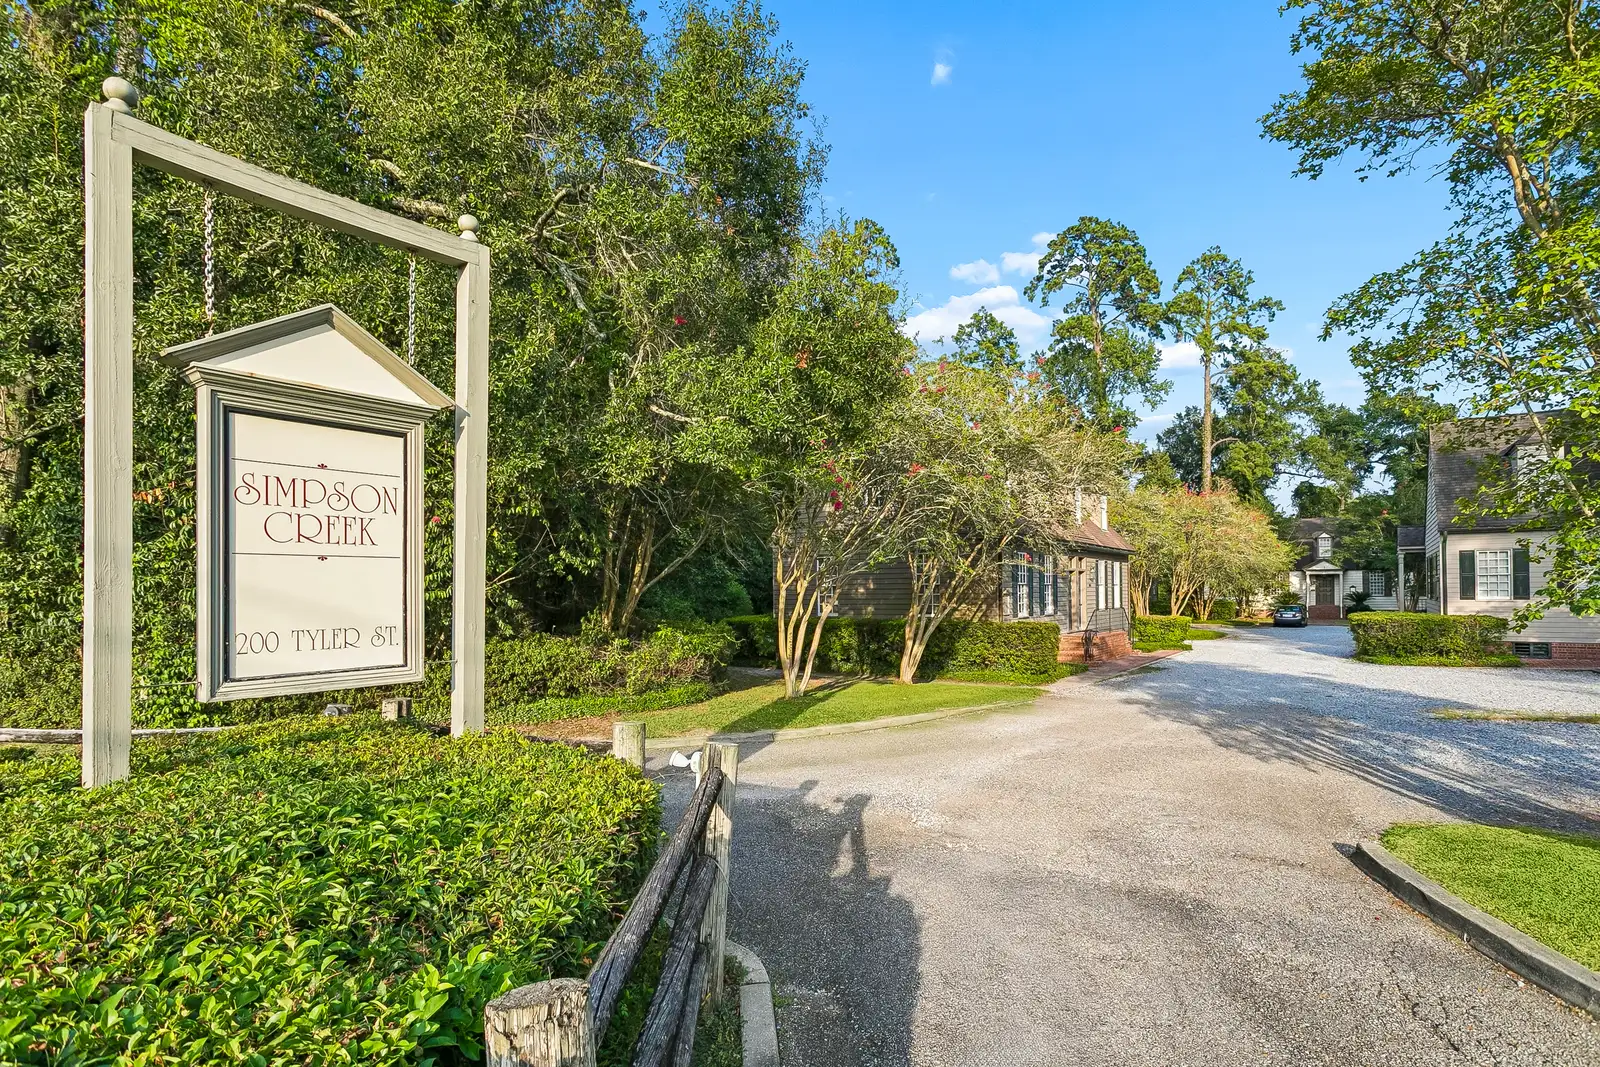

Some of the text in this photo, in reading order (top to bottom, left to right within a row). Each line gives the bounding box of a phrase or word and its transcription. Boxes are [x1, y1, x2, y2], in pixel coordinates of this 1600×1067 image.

[234, 472, 398, 515] SIMPSON
[264, 511, 378, 546] CREEK
[235, 625, 399, 655] 200 TYLER ST.
